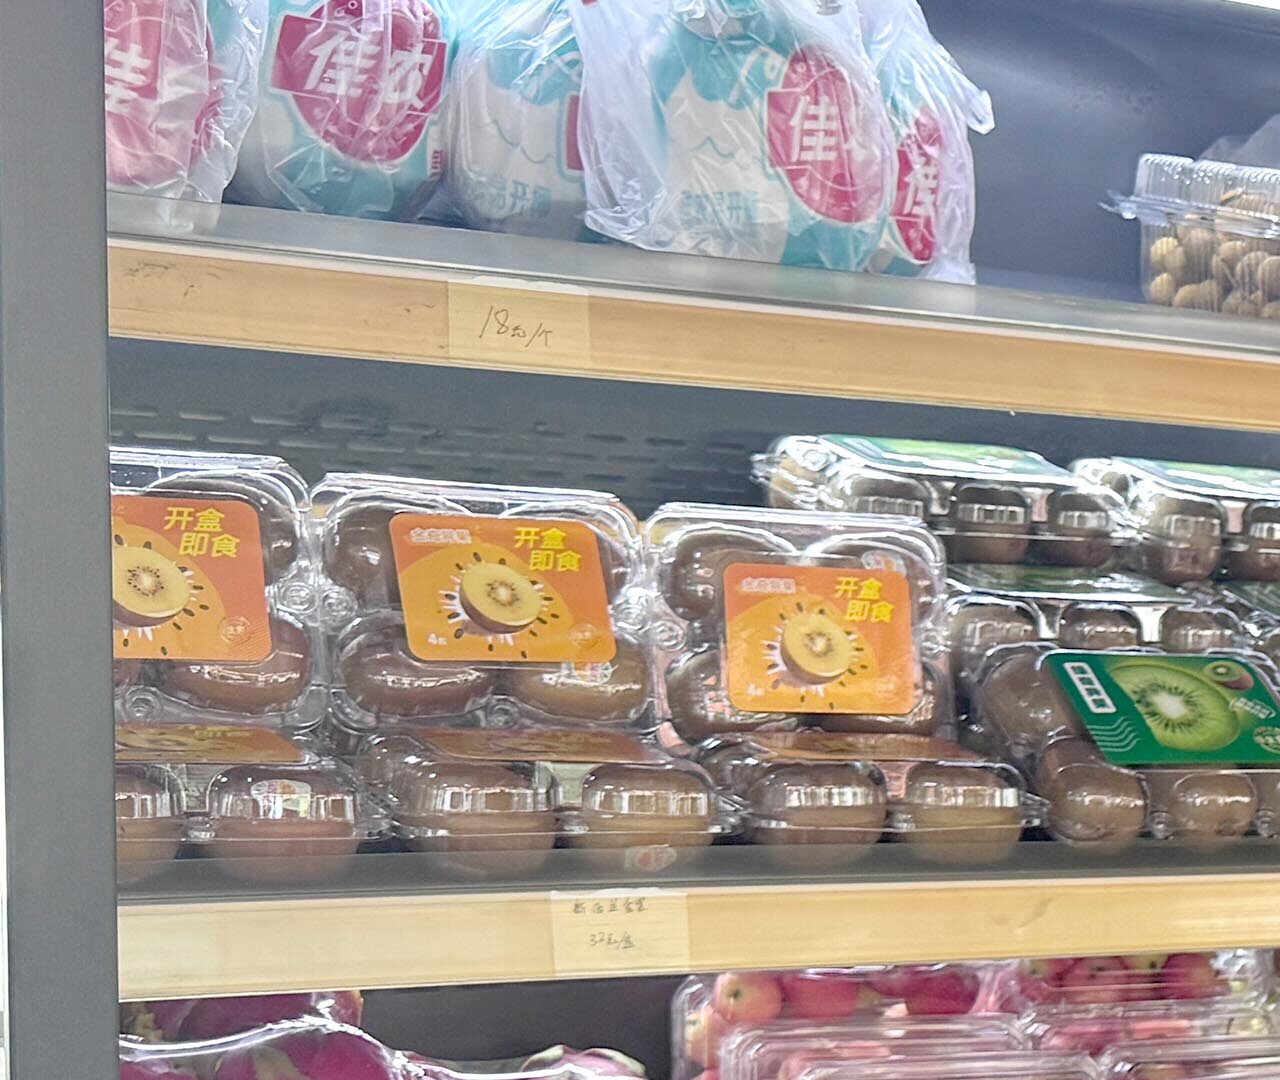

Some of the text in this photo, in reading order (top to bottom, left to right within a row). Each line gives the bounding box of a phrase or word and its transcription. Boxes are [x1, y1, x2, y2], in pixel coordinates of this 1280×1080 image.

[163, 506, 225, 532] 开盒
[179, 531, 241, 558] 即食
[514, 527, 566, 549] 开盒
[529, 549, 582, 572] 即食
[834, 576, 883, 599] 开盒
[845, 599, 895, 623] 即食
